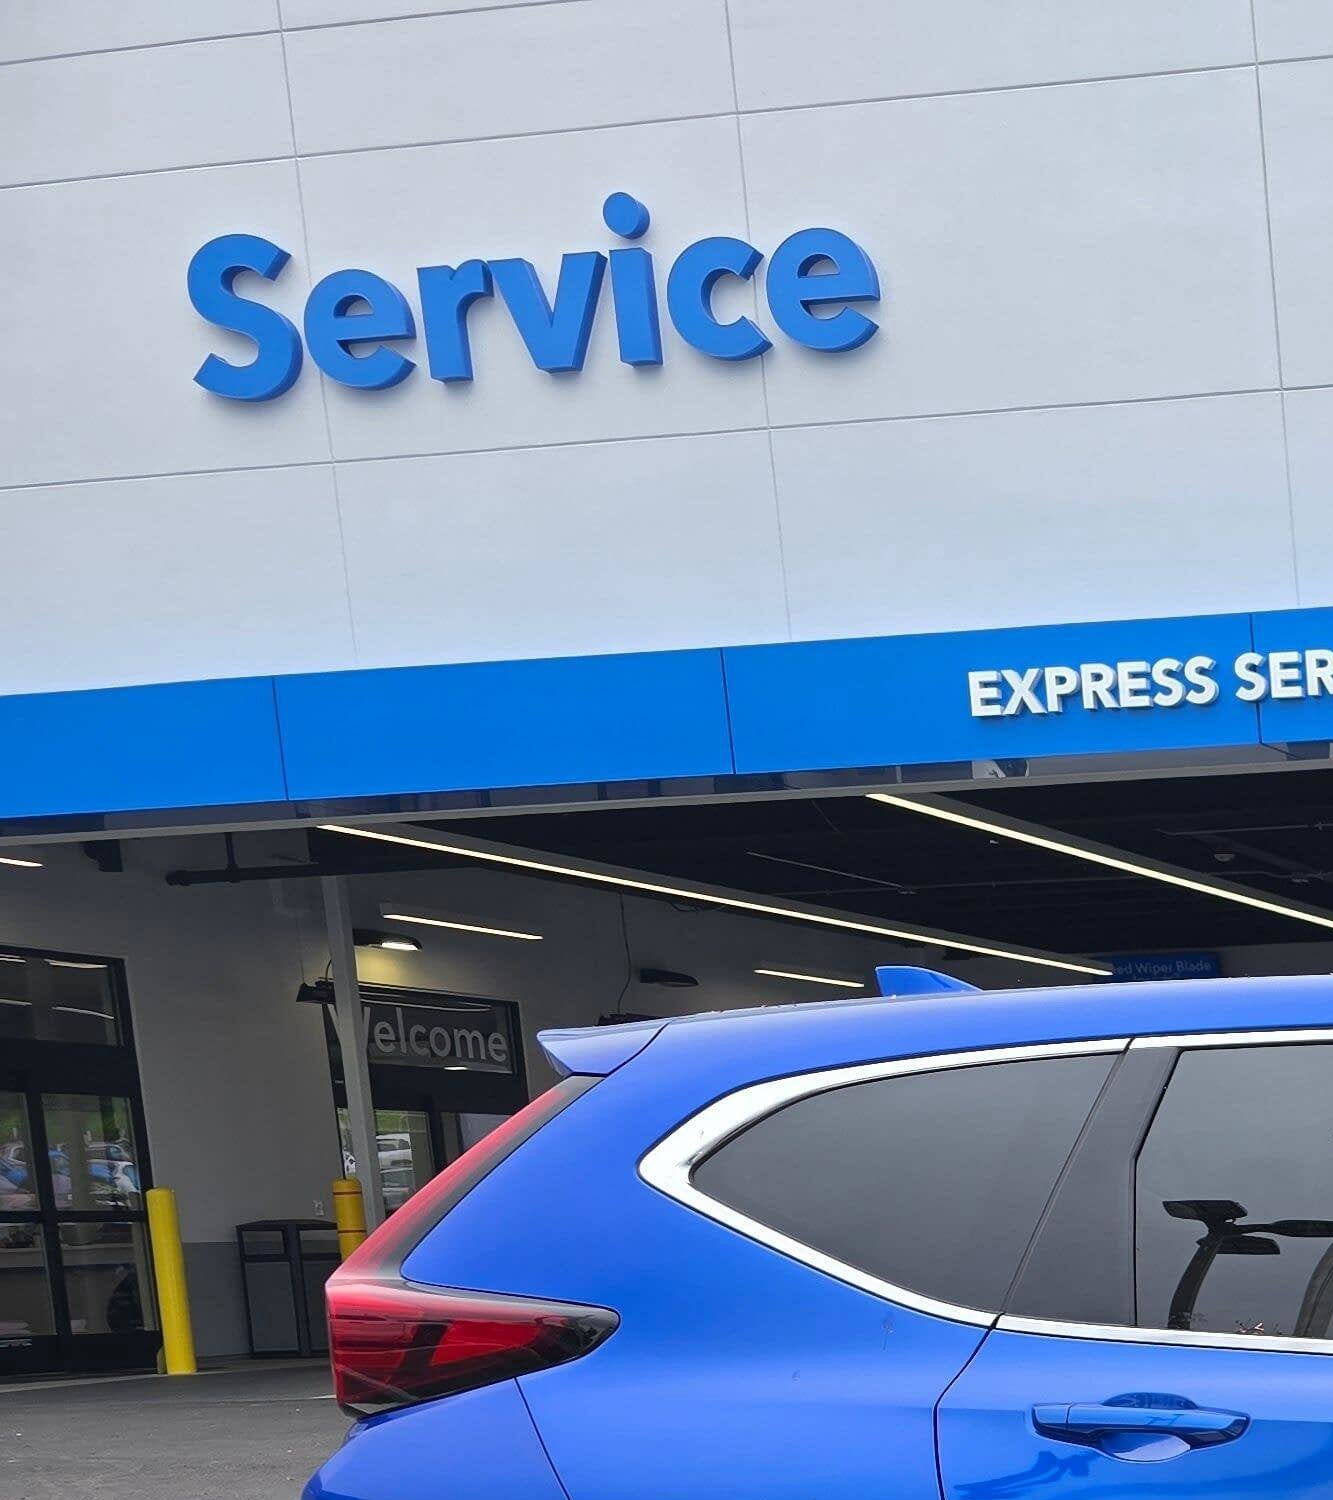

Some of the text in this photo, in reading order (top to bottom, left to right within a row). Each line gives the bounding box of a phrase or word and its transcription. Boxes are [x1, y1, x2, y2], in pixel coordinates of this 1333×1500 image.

[187, 192, 881, 402] Service
[967, 656, 1219, 718] EXPRESS
[1135, 961, 1173, 976] Wiper
[1175, 960, 1211, 972] Blade
